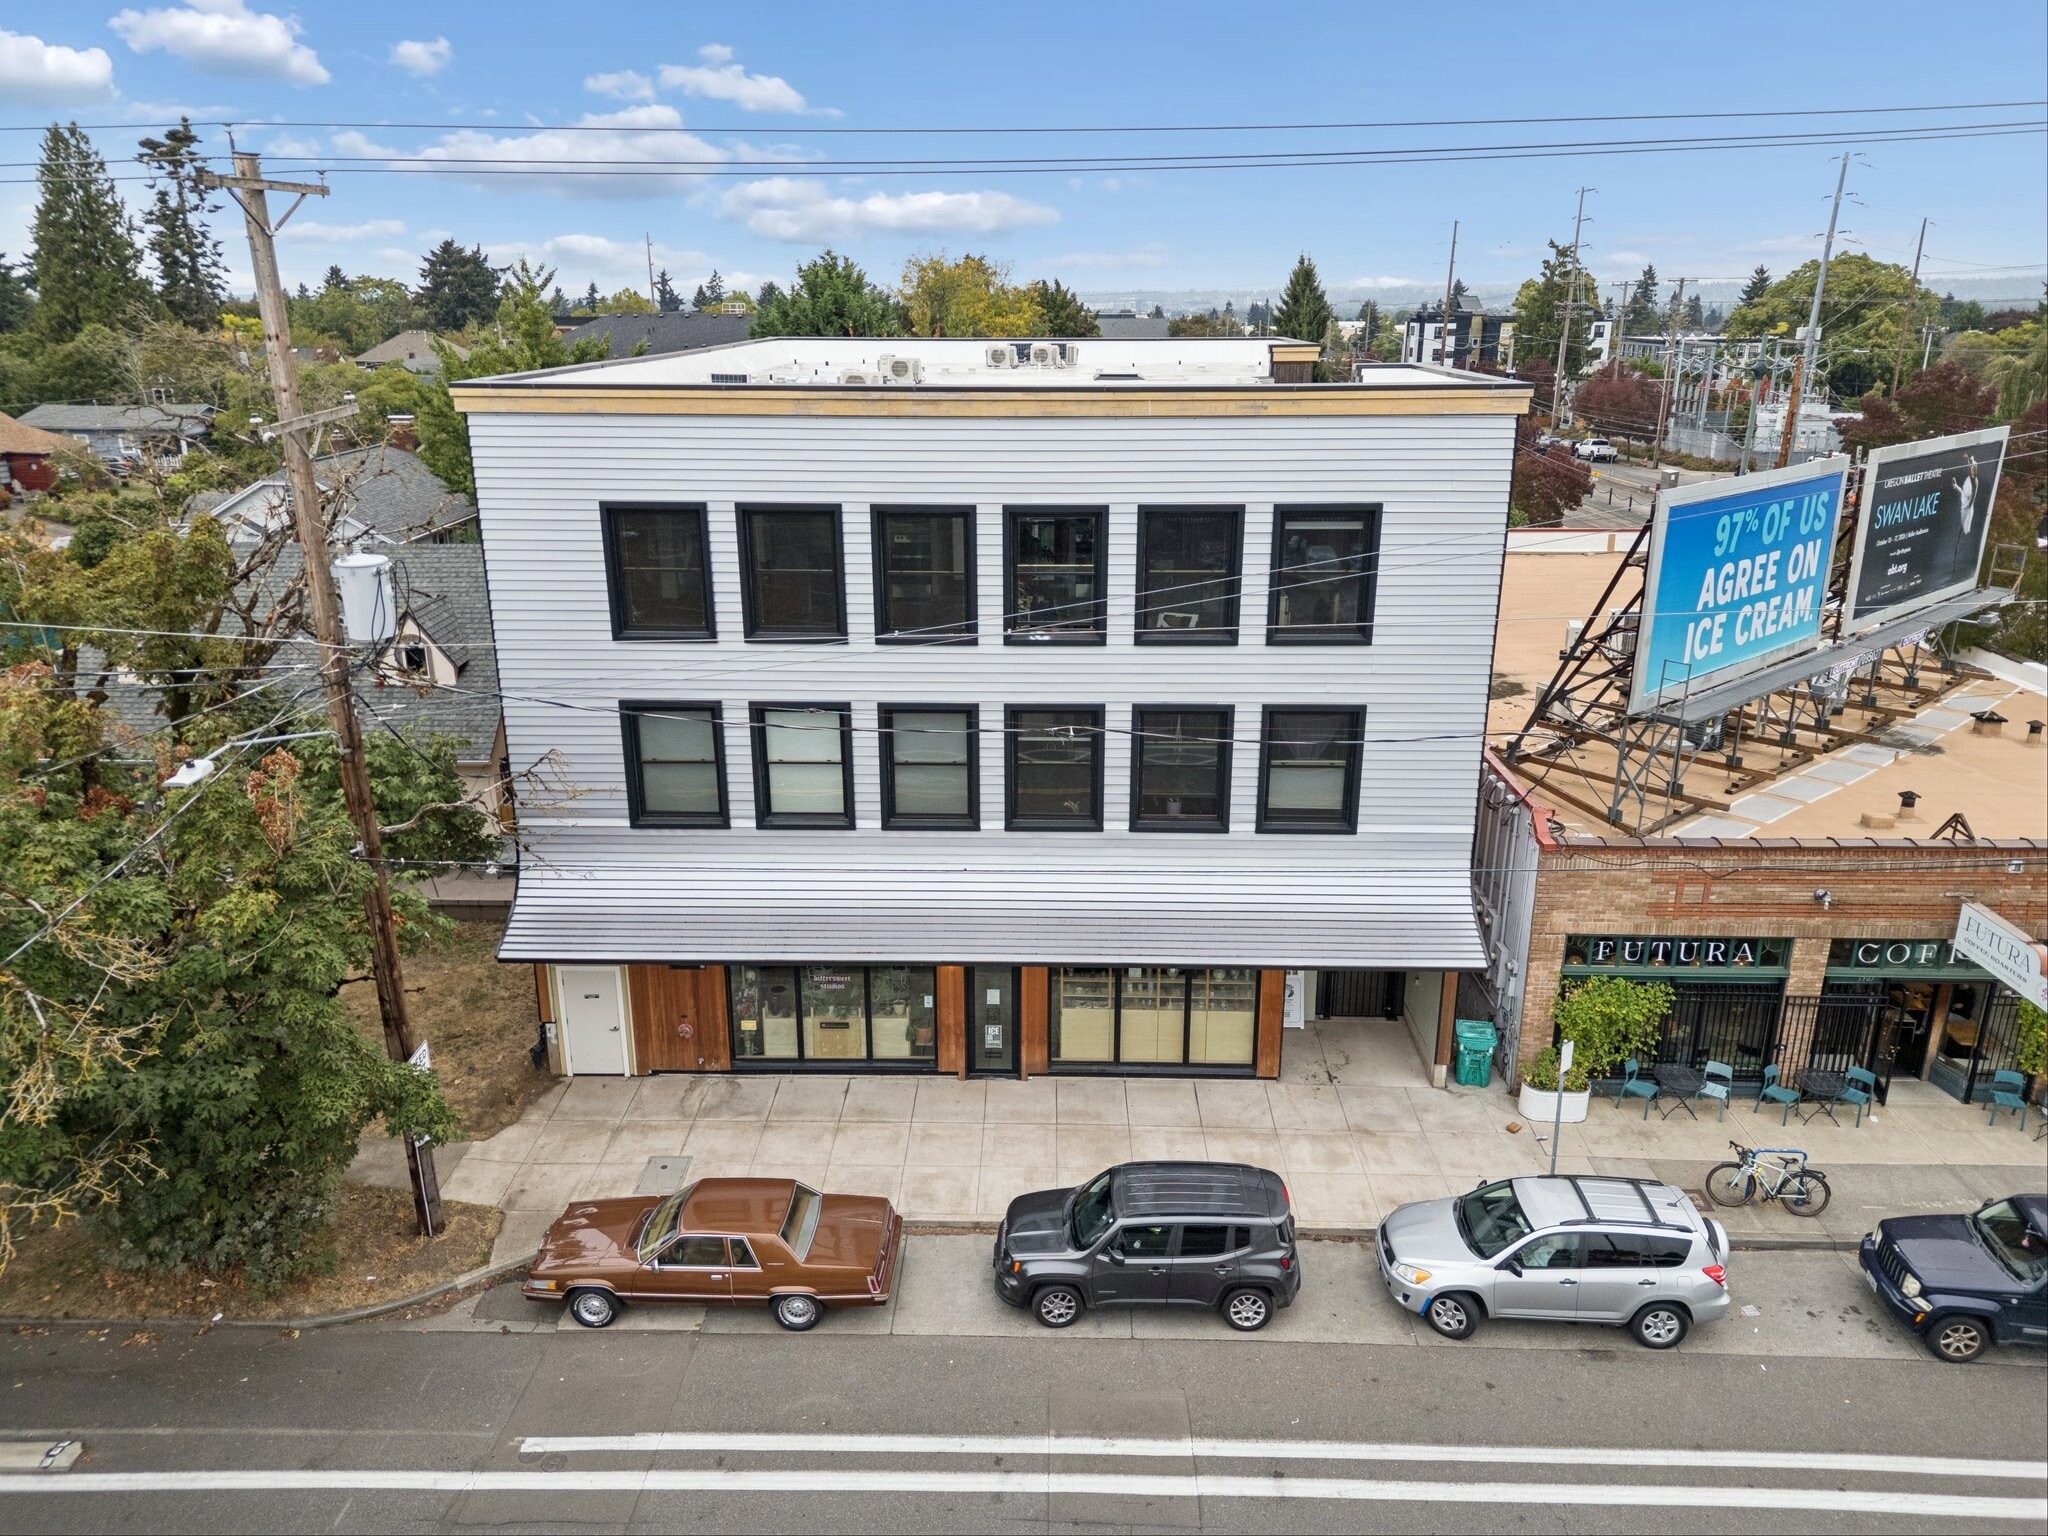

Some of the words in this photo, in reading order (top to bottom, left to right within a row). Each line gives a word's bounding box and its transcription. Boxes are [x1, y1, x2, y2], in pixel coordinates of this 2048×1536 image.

[1713, 507, 1759, 557] 97%
[1762, 500, 1795, 545] OF
[1800, 492, 1830, 535] US
[1874, 498, 1913, 530] SWAN
[1913, 492, 1941, 520] LAKE
[1696, 550, 1781, 612] AGREE
[1787, 538, 1822, 585] ON
[1683, 613, 1727, 664] ICE
[1735, 585, 1814, 646] CREAM.
[1595, 941, 1755, 962] FUTURA
[1964, 937, 1990, 958] COFFEE
[1990, 955, 2028, 984] ROASTERS
[1966, 916, 2031, 974] FUTURA
